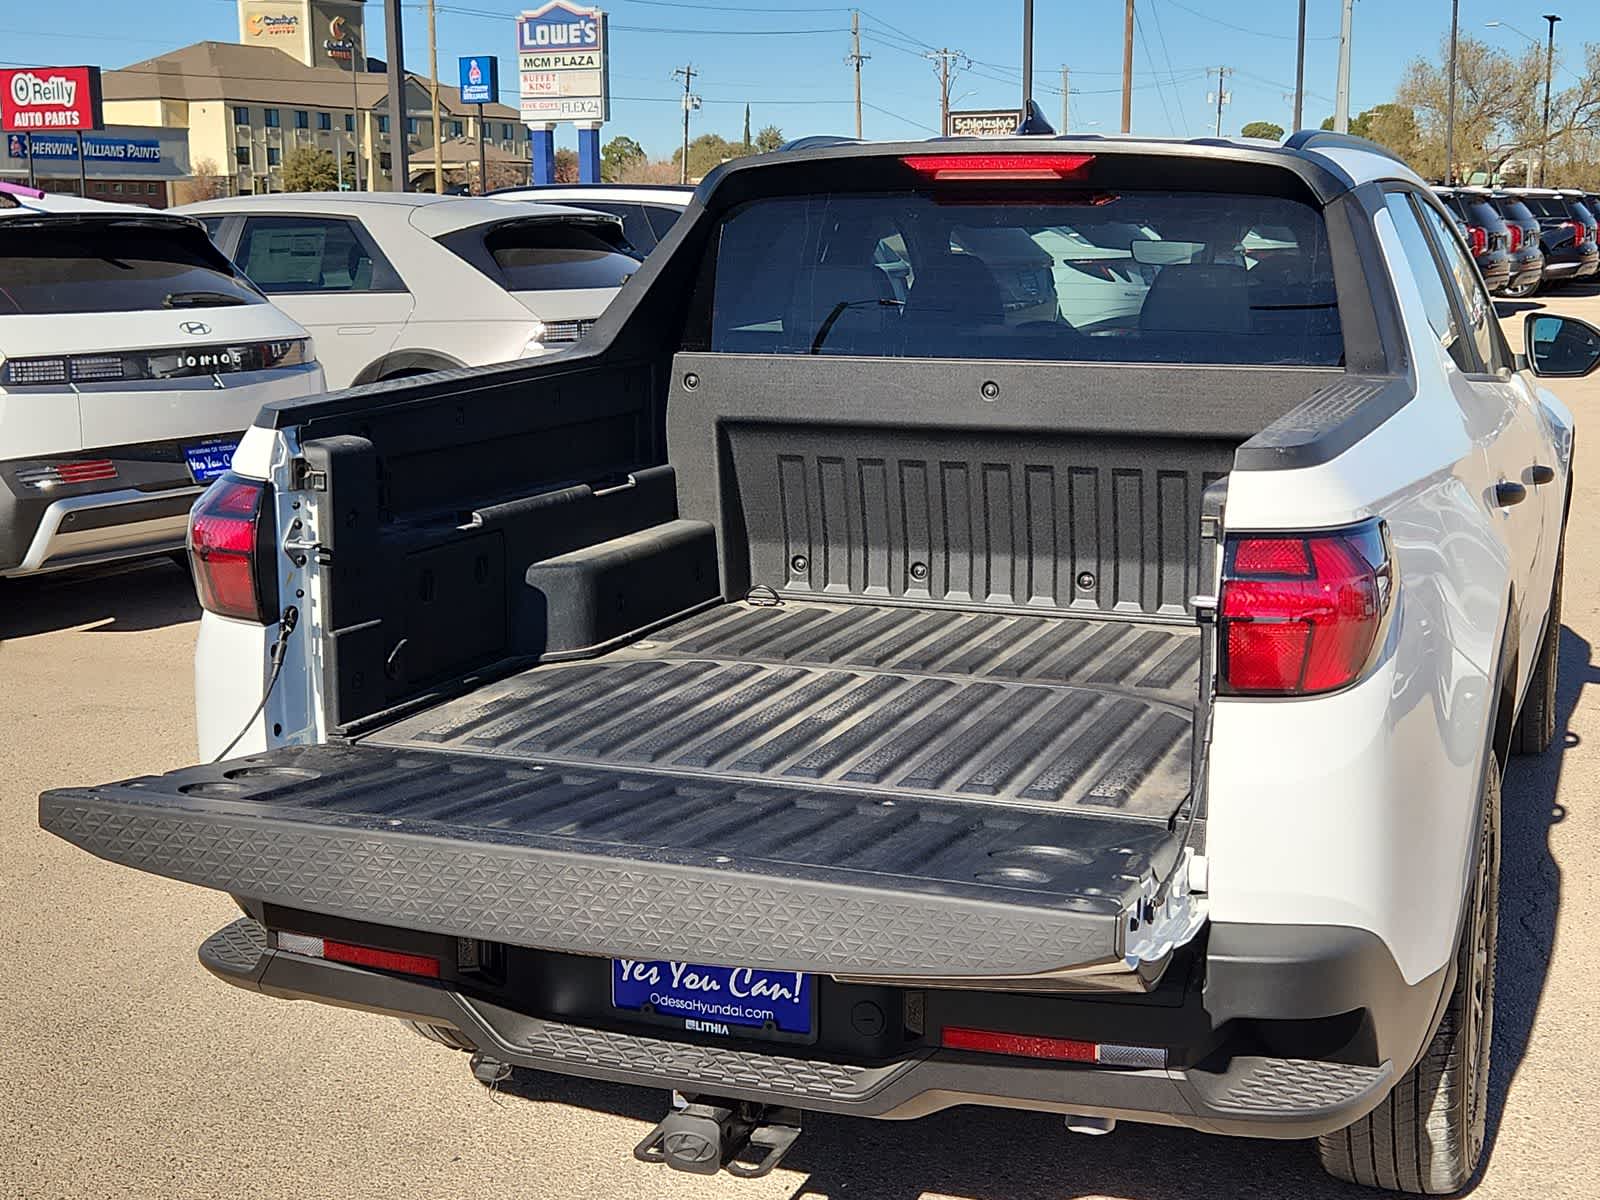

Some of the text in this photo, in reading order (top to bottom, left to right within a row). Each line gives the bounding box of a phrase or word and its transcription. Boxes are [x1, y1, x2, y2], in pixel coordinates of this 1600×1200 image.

[523, 20, 597, 46] LOWE'S
[523, 56, 594, 68] MCM PLAZA
[13, 75, 76, 106] O'Reilly
[528, 83, 552, 91] KING
[14, 111, 80, 127] AUTO PARTS
[955, 116, 1015, 130] Schlotzsky's
[127, 144, 161, 159] PAINTS
[620, 959, 803, 1004] Yes You Can!
[650, 992, 774, 1021] OdessaHyundai.com
[694, 1021, 730, 1035] LITHIA
